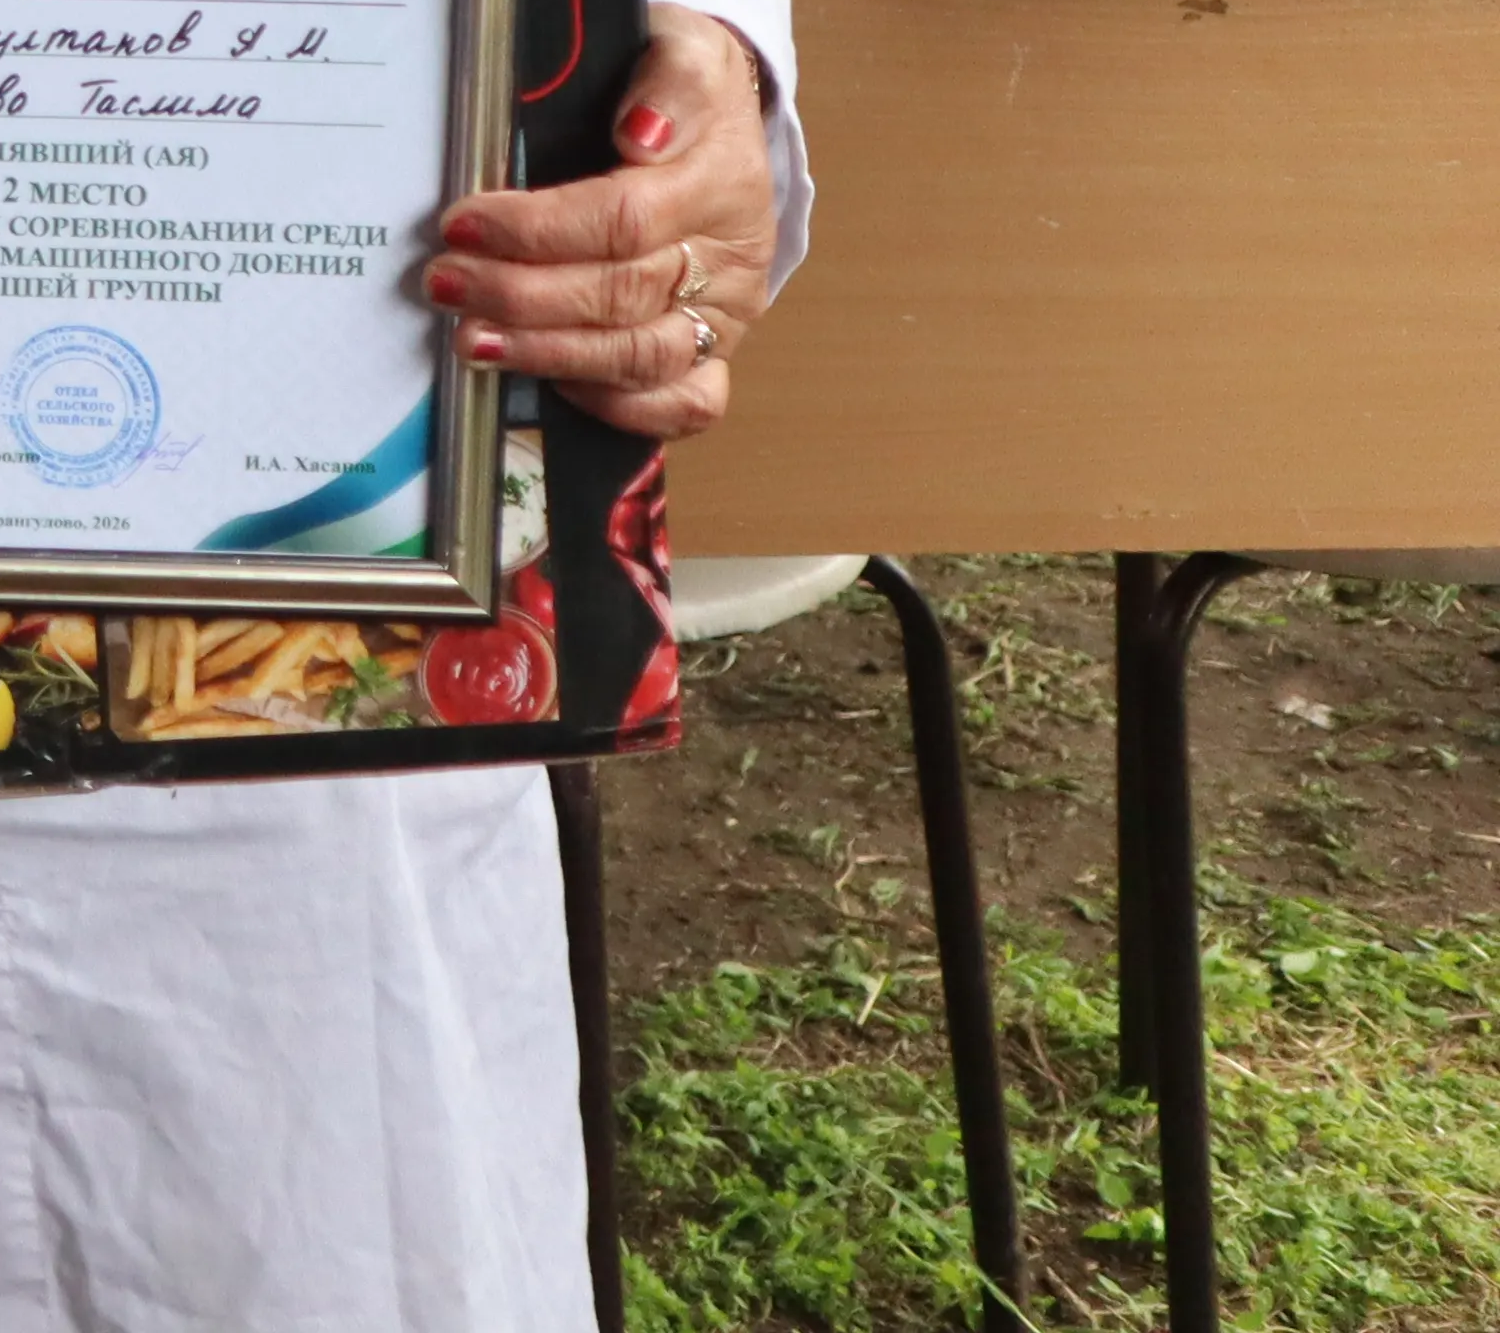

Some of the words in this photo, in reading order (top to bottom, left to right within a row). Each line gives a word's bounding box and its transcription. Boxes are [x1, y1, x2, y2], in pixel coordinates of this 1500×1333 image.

[143, 143, 209, 170] (АЯ)
[3, 179, 19, 204] 2
[29, 183, 147, 207] МЕСТО
[8, 215, 274, 243] СОРЕВНОВАНИИ
[282, 224, 388, 249] СРЕДИ
[0, 246, 221, 273] МАШИННОГО
[229, 252, 364, 278] ДОЕНИЯ
[87, 278, 222, 303] ГРУППЫ
[294, 456, 376, 475] Хасанов
[92, 516, 131, 532] 2026
